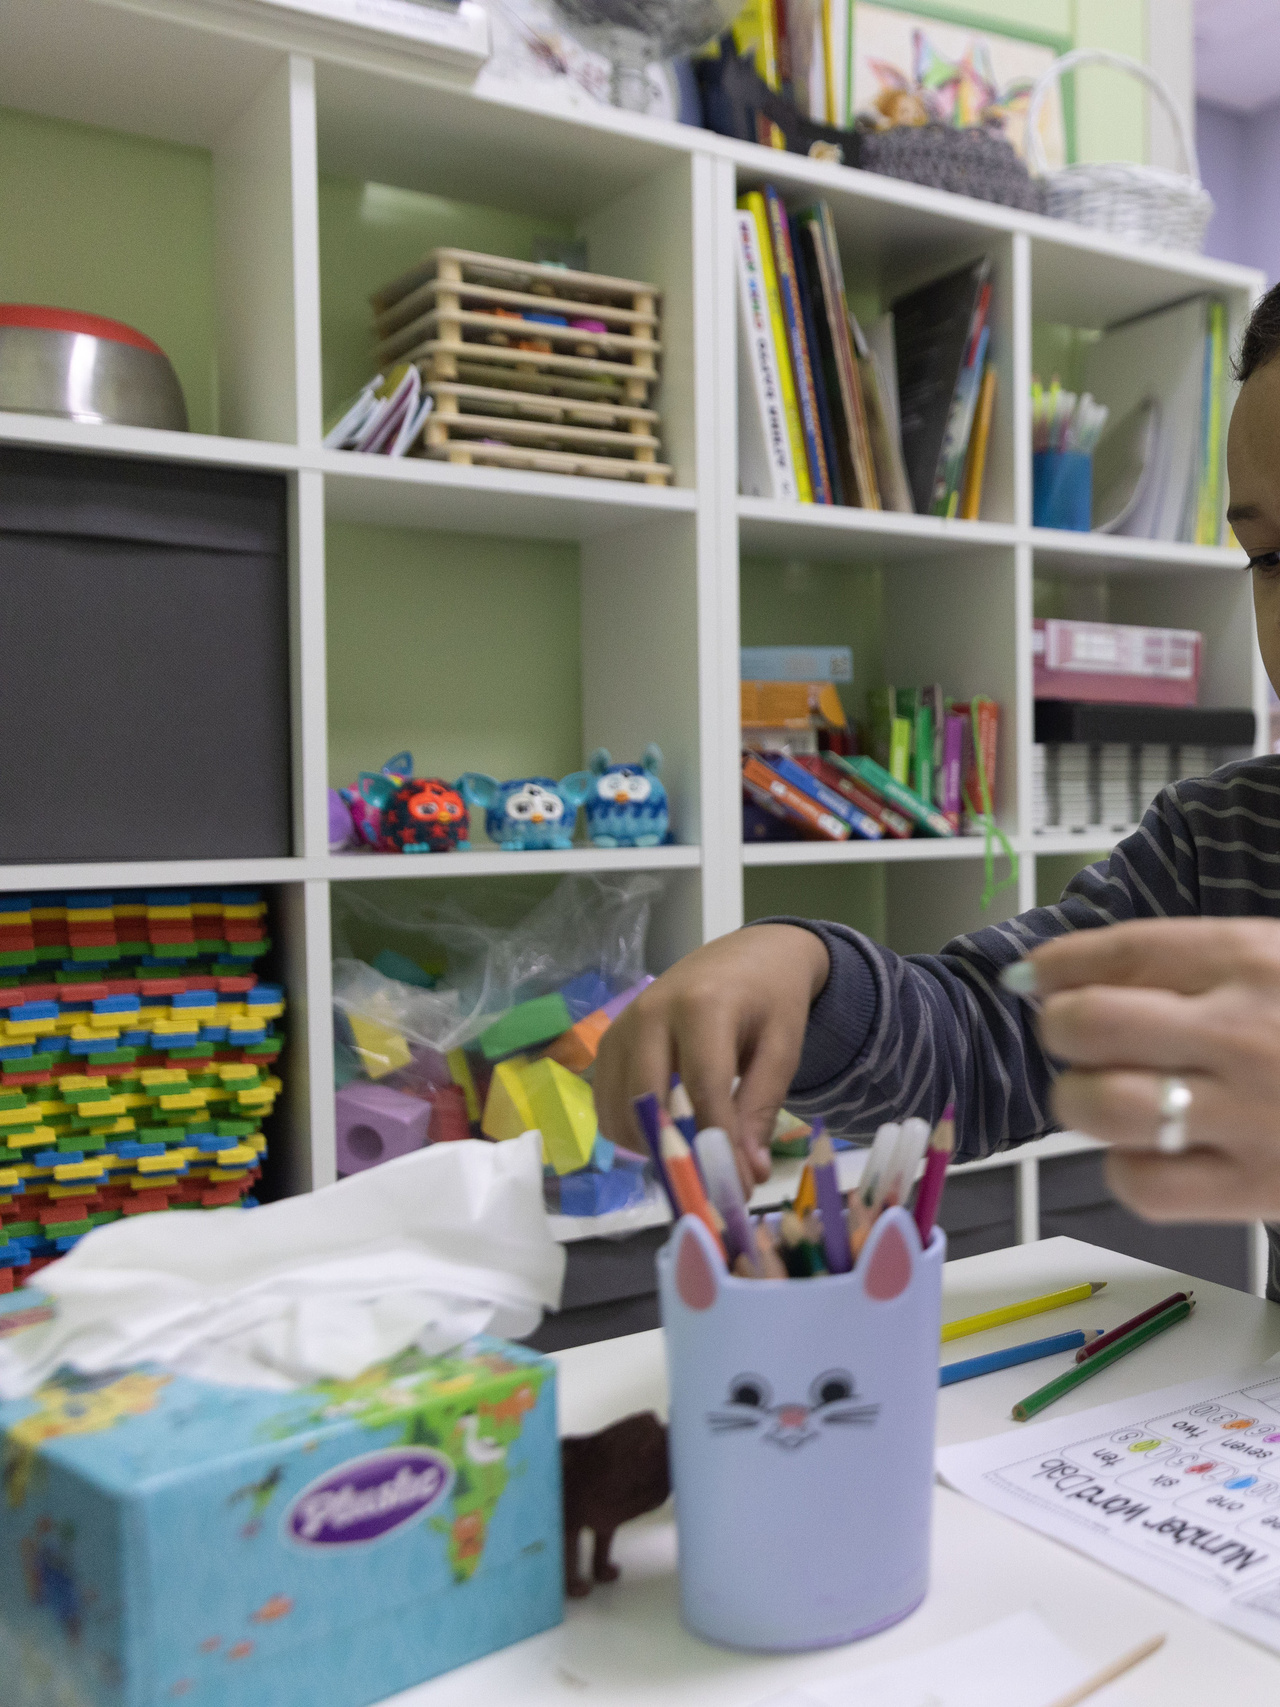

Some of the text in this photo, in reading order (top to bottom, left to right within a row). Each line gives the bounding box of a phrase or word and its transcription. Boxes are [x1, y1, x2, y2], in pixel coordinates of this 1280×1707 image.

[1171, 1421, 1208, 1439] two
[1220, 1438, 1273, 1458] seven
[1092, 1448, 1125, 1468] ten
[1151, 1473, 1181, 1488] six
[1205, 1494, 1244, 1511] one
[1032, 1458, 1266, 1571] Number Word Dab
